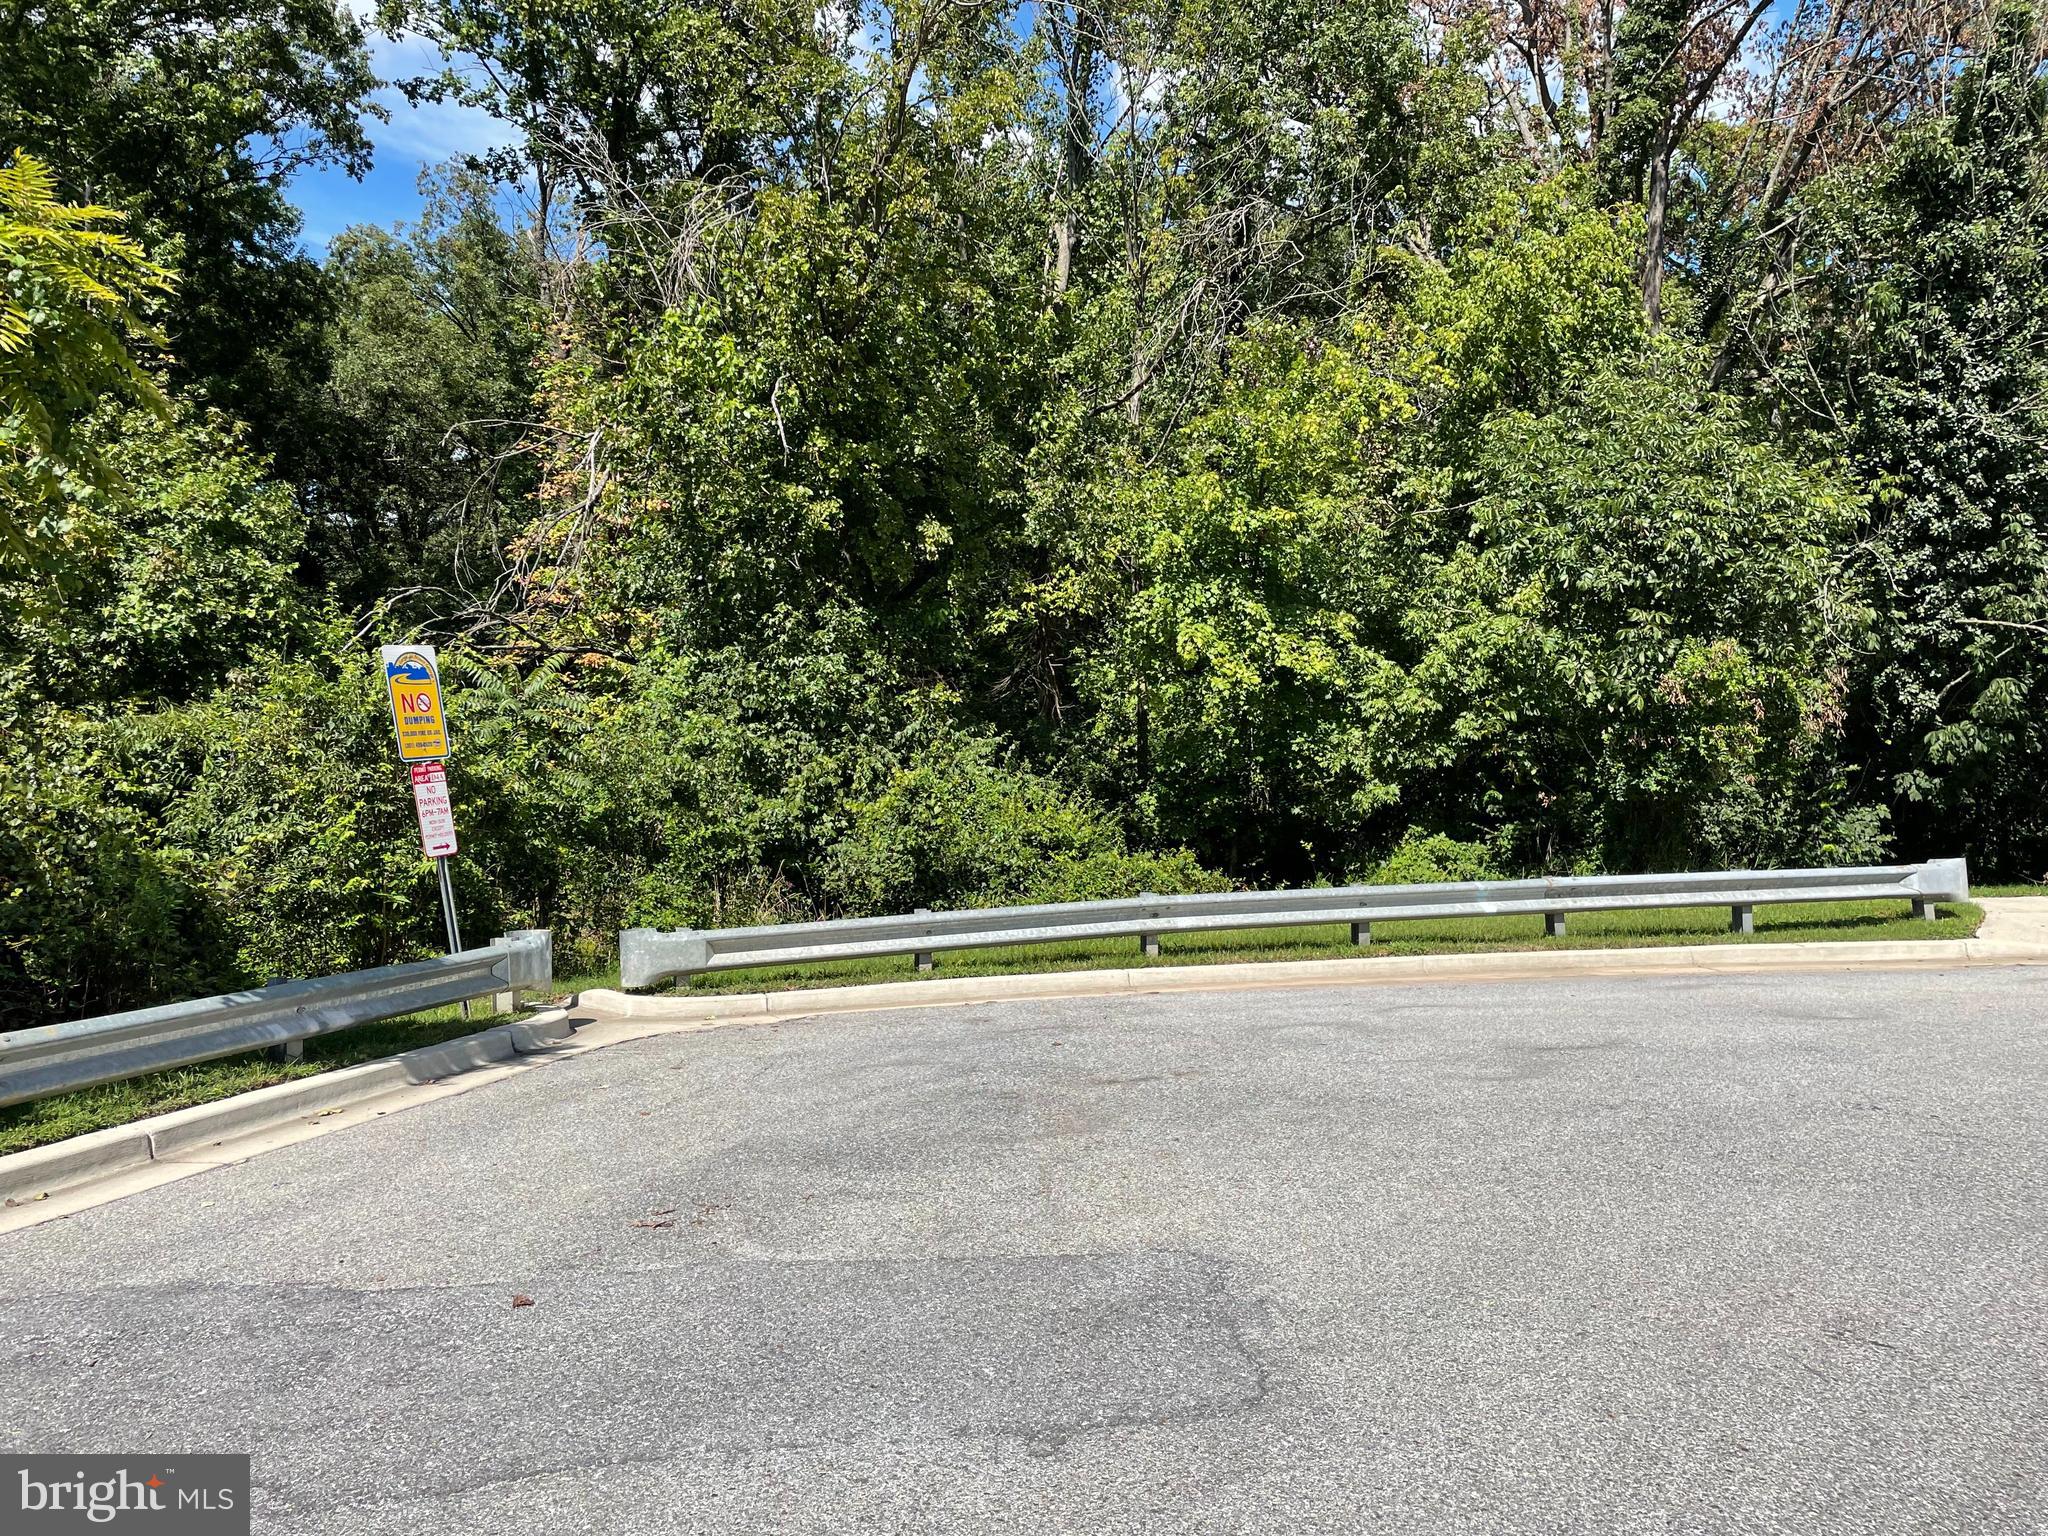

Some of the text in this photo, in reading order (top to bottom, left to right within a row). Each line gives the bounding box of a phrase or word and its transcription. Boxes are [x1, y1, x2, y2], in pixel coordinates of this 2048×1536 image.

[401, 693, 431, 713] NO
[404, 716, 435, 725] DUMPING
[414, 775, 429, 783] AREA
[426, 786, 436, 794] NO
[419, 796, 447, 807] PARKING
